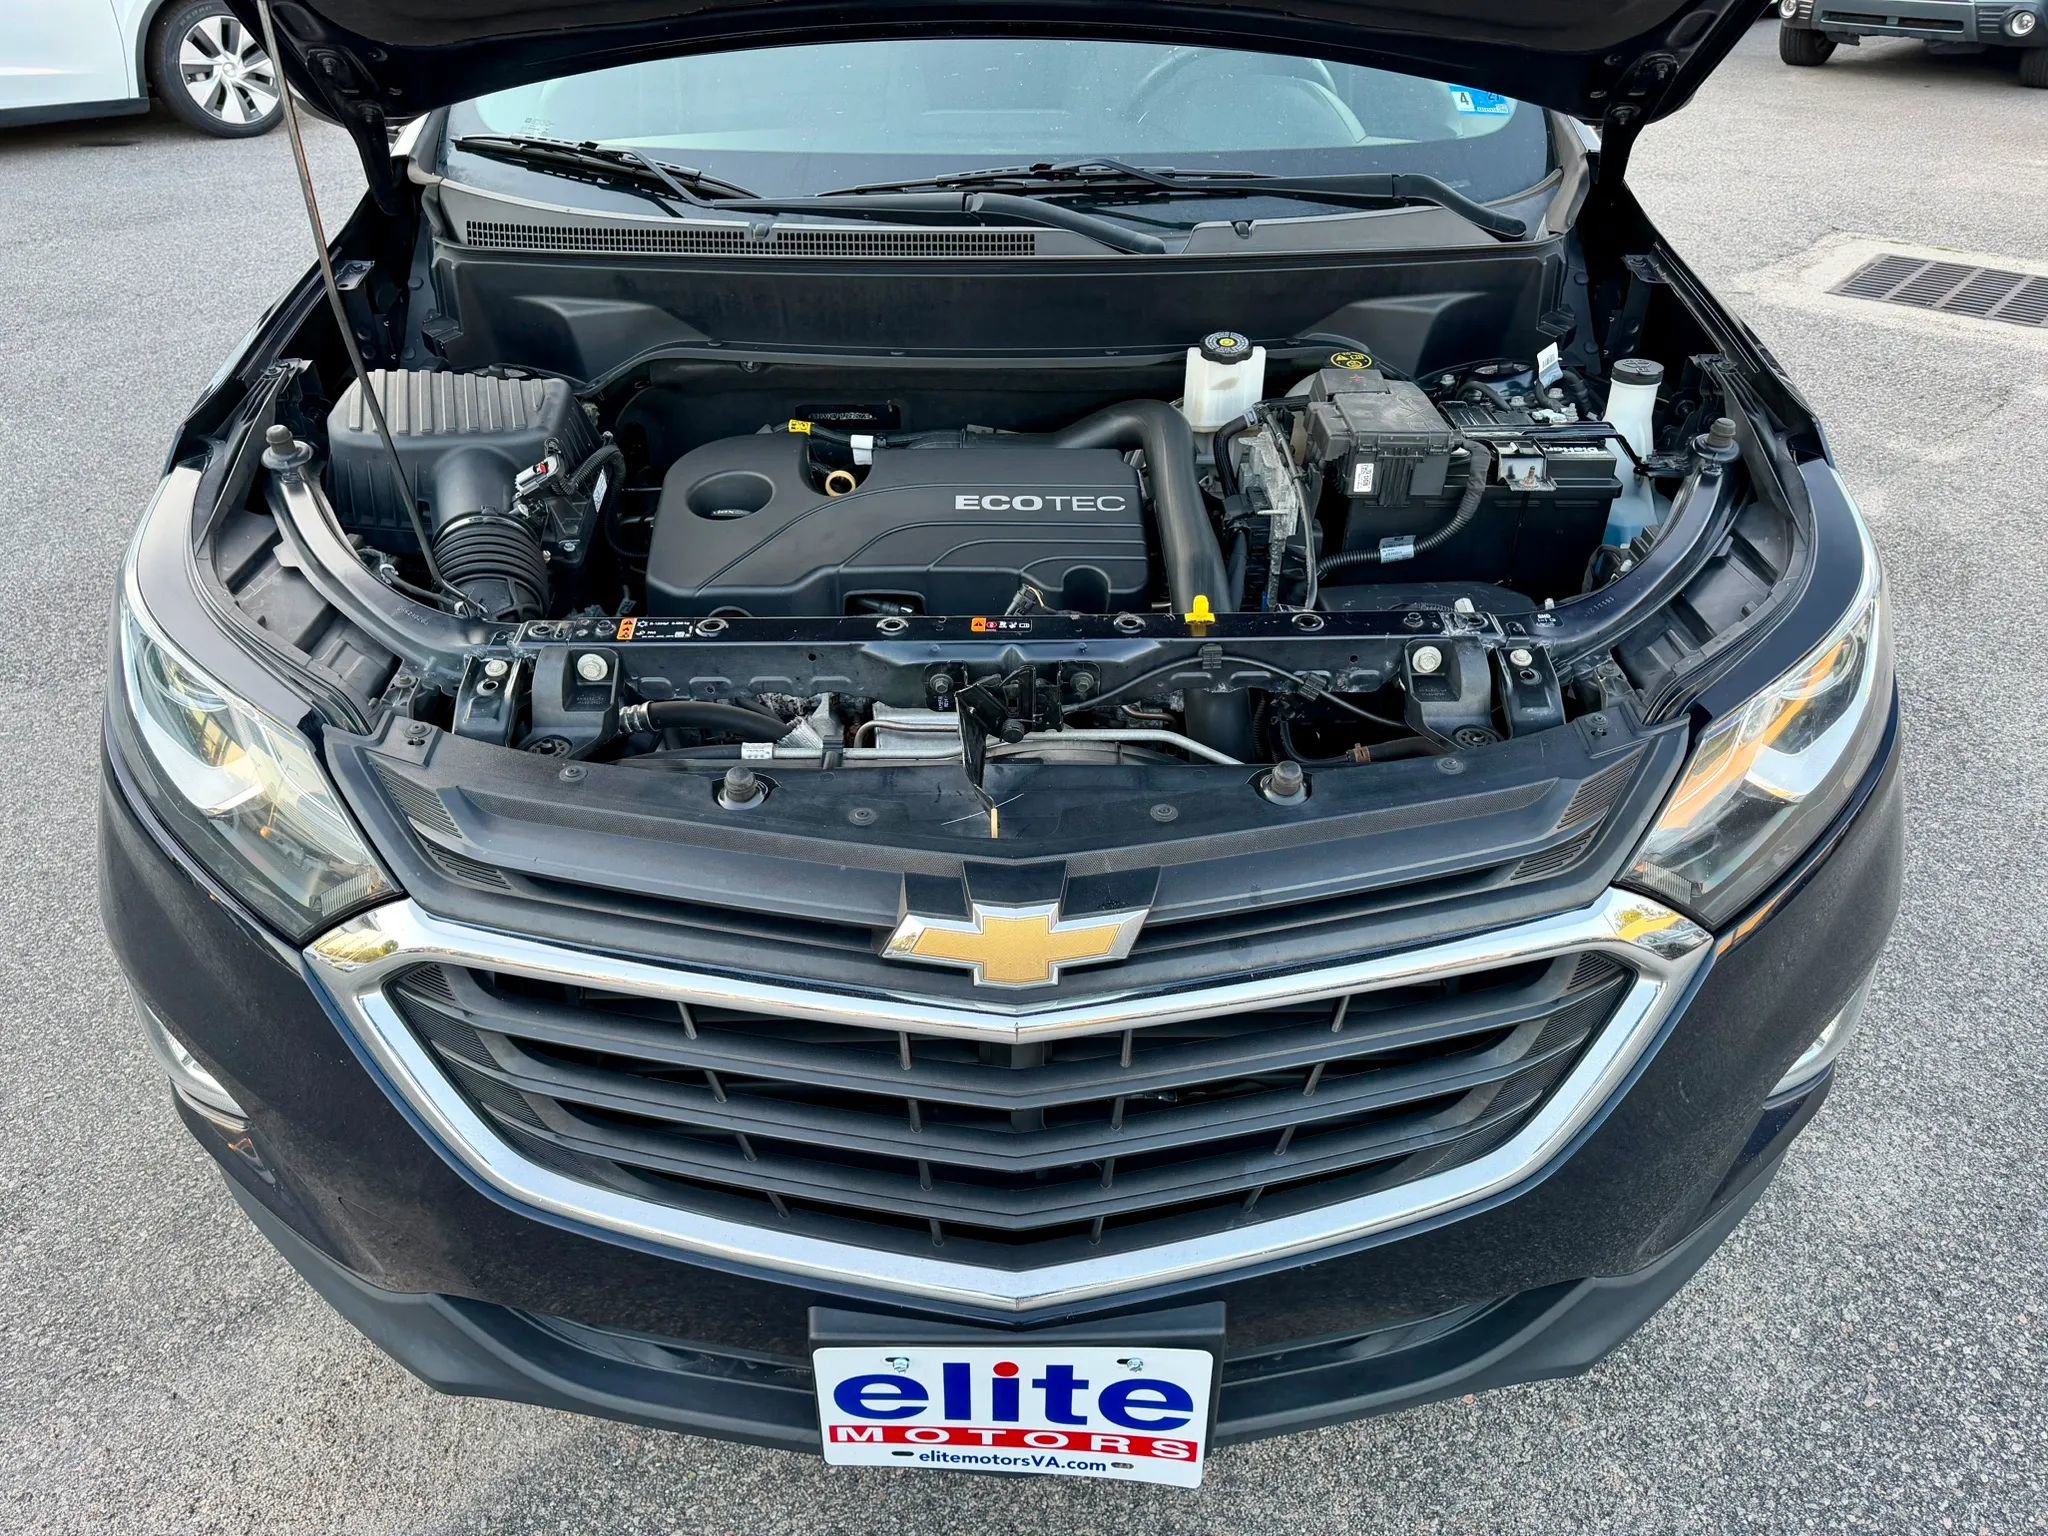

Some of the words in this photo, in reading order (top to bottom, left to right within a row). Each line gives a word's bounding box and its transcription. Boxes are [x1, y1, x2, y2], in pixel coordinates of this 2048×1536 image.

[955, 495, 1126, 512] ECOTEC
[833, 1361, 1194, 1431] elite
[836, 1427, 1192, 1459] MOTORS
[919, 1449, 1107, 1472] elitemotorsVA.com
